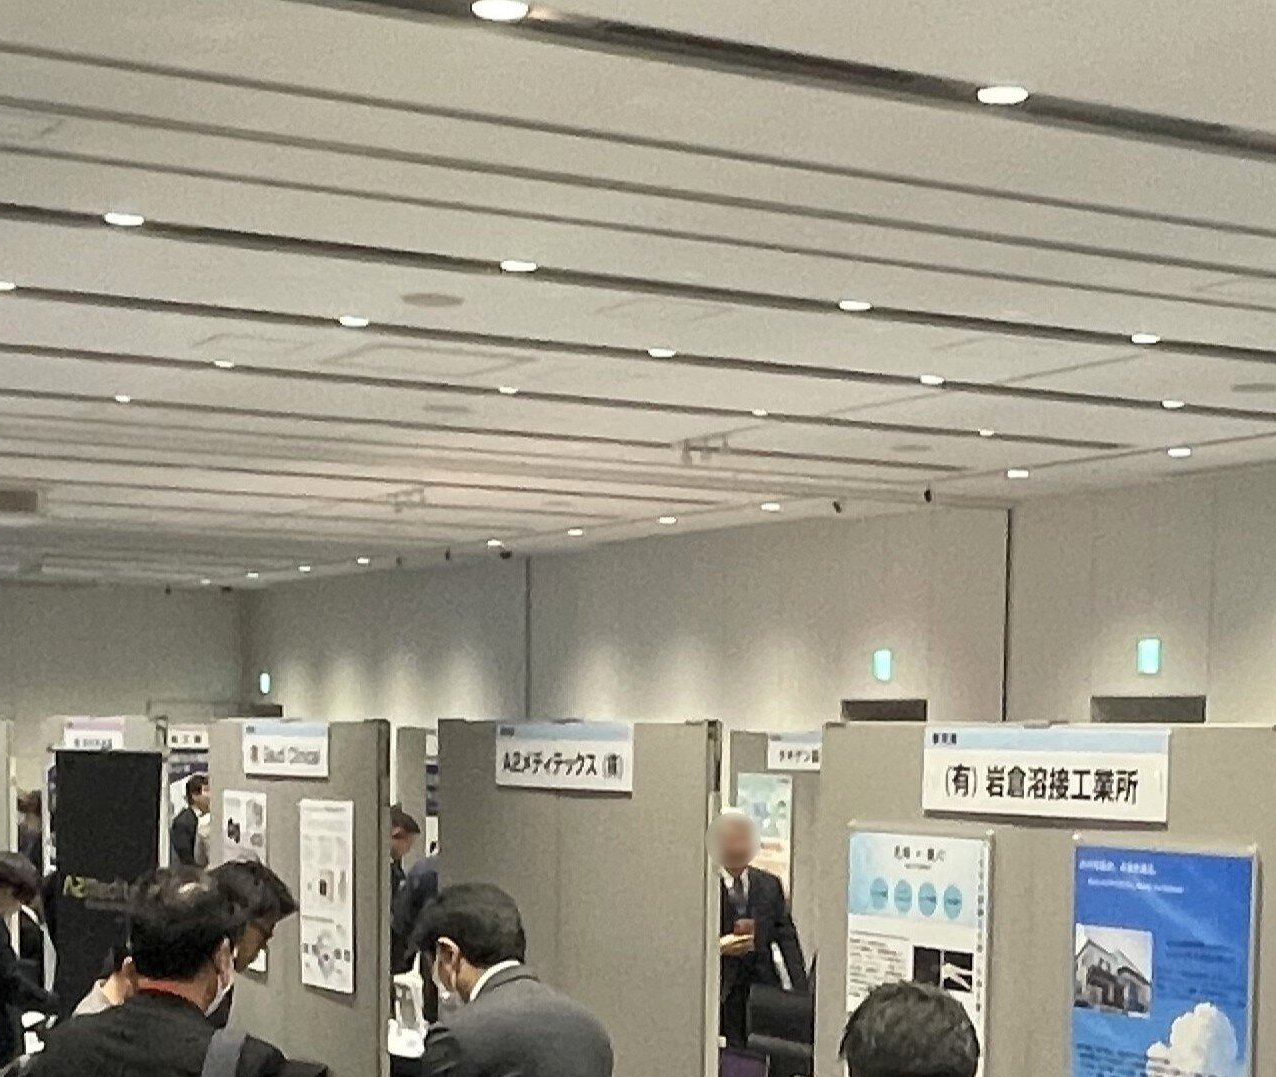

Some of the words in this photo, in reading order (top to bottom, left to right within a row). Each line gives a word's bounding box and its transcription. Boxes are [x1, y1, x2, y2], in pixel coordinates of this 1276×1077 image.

[945, 763, 977, 798] (有)
[985, 765, 1139, 805] 岩倉溶接工業所
